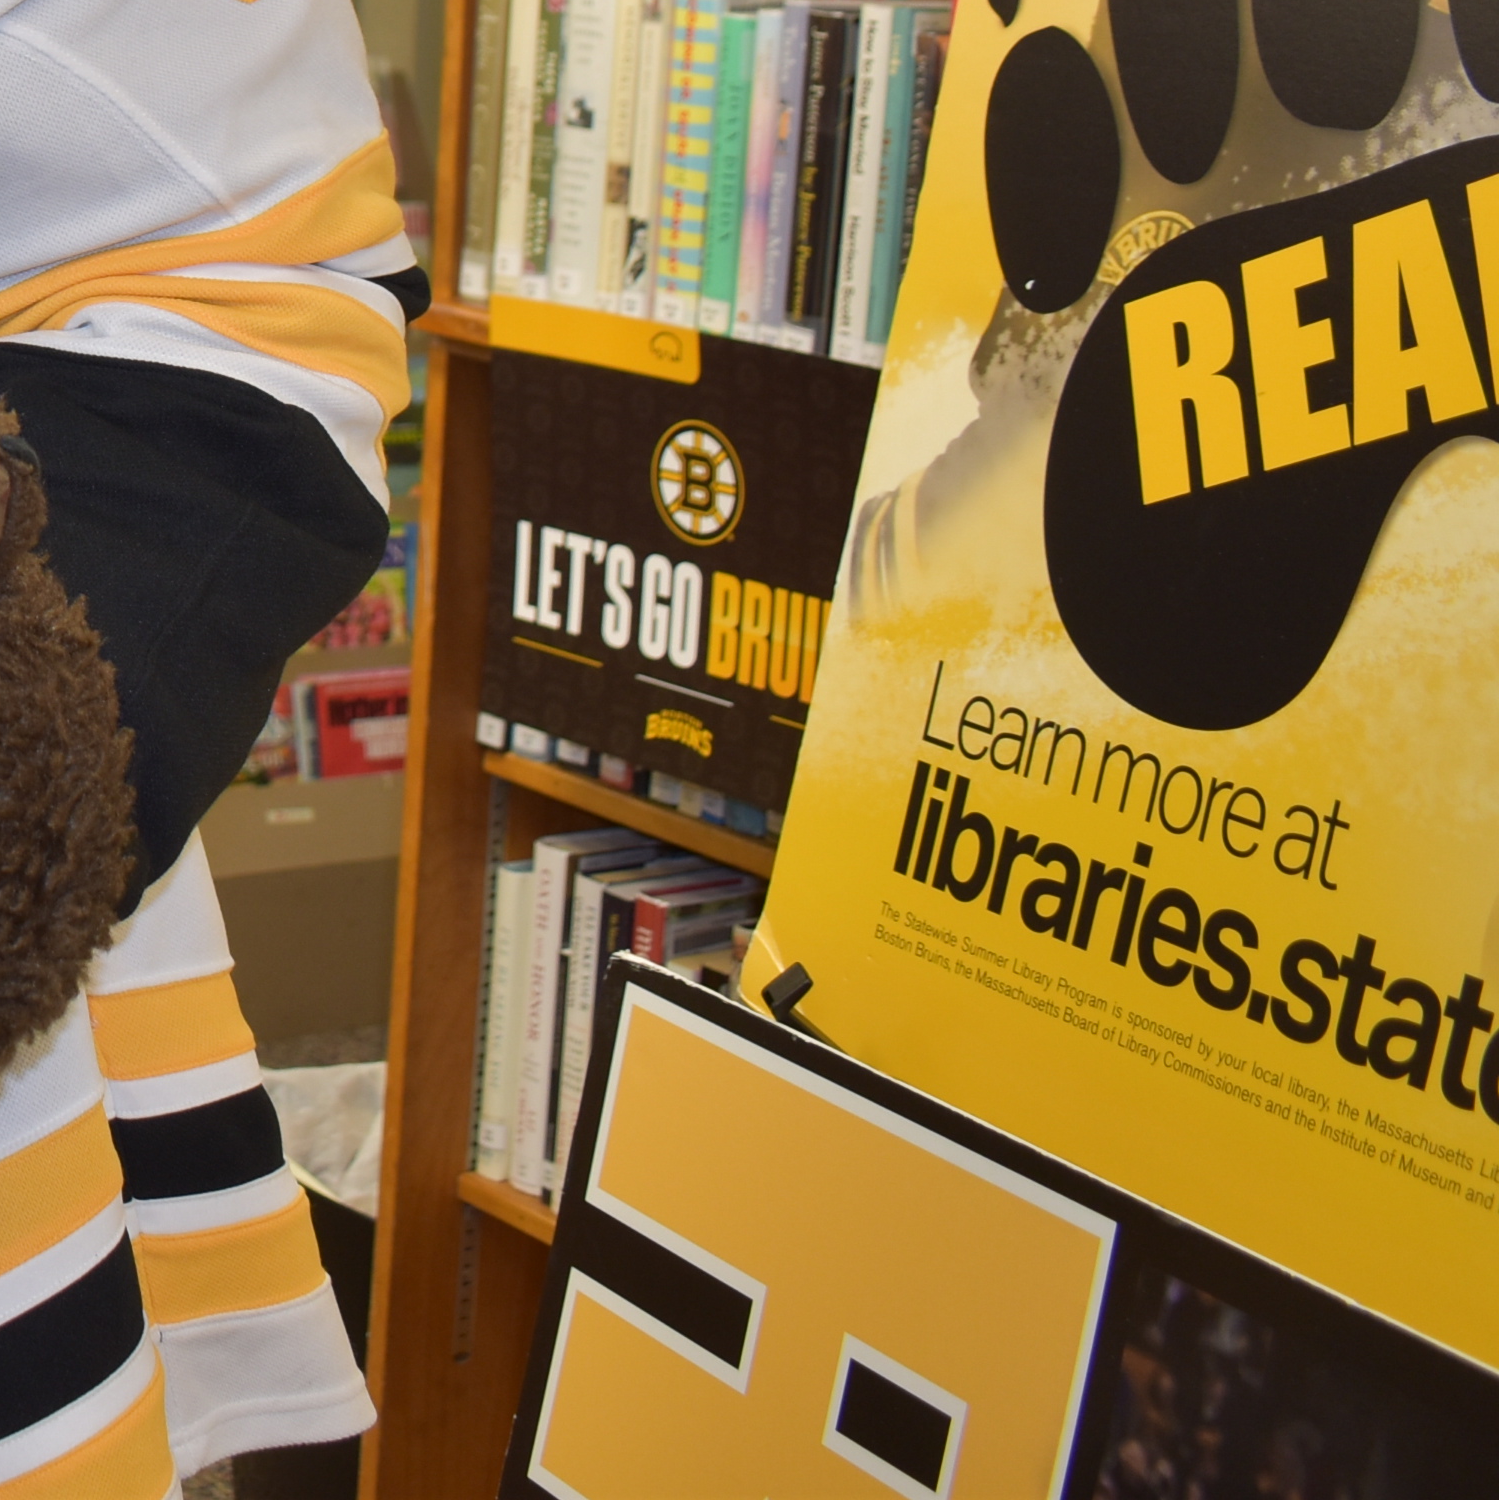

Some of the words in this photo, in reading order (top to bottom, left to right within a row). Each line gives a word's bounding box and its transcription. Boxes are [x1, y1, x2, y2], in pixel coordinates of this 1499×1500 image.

[1123, 172, 1499, 506] REA
[512, 519, 636, 649] LET'S
[637, 552, 704, 670] GO
[705, 569, 834, 706] BRUI
[921, 659, 1087, 795] Learn
[1092, 740, 1268, 859] more
[1273, 798, 1351, 890] at
[874, 923, 913, 953] Boston
[914, 942, 953, 973] Bruins,
[954, 959, 973, 980] the
[974, 967, 1060, 1019] Massachusetts
[1062, 1005, 1099, 1036] Board
[1101, 1026, 1118, 1042] of
[1117, 1030, 1160, 1066] Library
[1163, 1050, 1263, 1108] Commissioners
[1264, 1099, 1292, 1121] and
[1294, 1109, 1317, 1132] the
[1320, 1119, 1377, 1159] Institute
[1379, 1149, 1396, 1166] of
[1398, 1153, 1462, 1196] Museum
[1464, 1187, 1495, 1212] and
[881, 900, 901, 923] The
[904, 911, 958, 948] Statewide
[961, 936, 1009, 969] Summer
[1012, 958, 1054, 992] Library
[1056, 977, 1108, 1012] Program
[1111, 1002, 1123, 1019] is
[1126, 1011, 1194, 1049] sponsored
[1197, 1038, 1214, 1062] by
[1215, 1049, 1248, 1072] your
[1251, 1061, 1285, 1089] local
[1287, 1075, 1331, 1113] library,
[1336, 1098, 1361, 1122] the
[1364, 1109, 1474, 1172] Massachusetts
